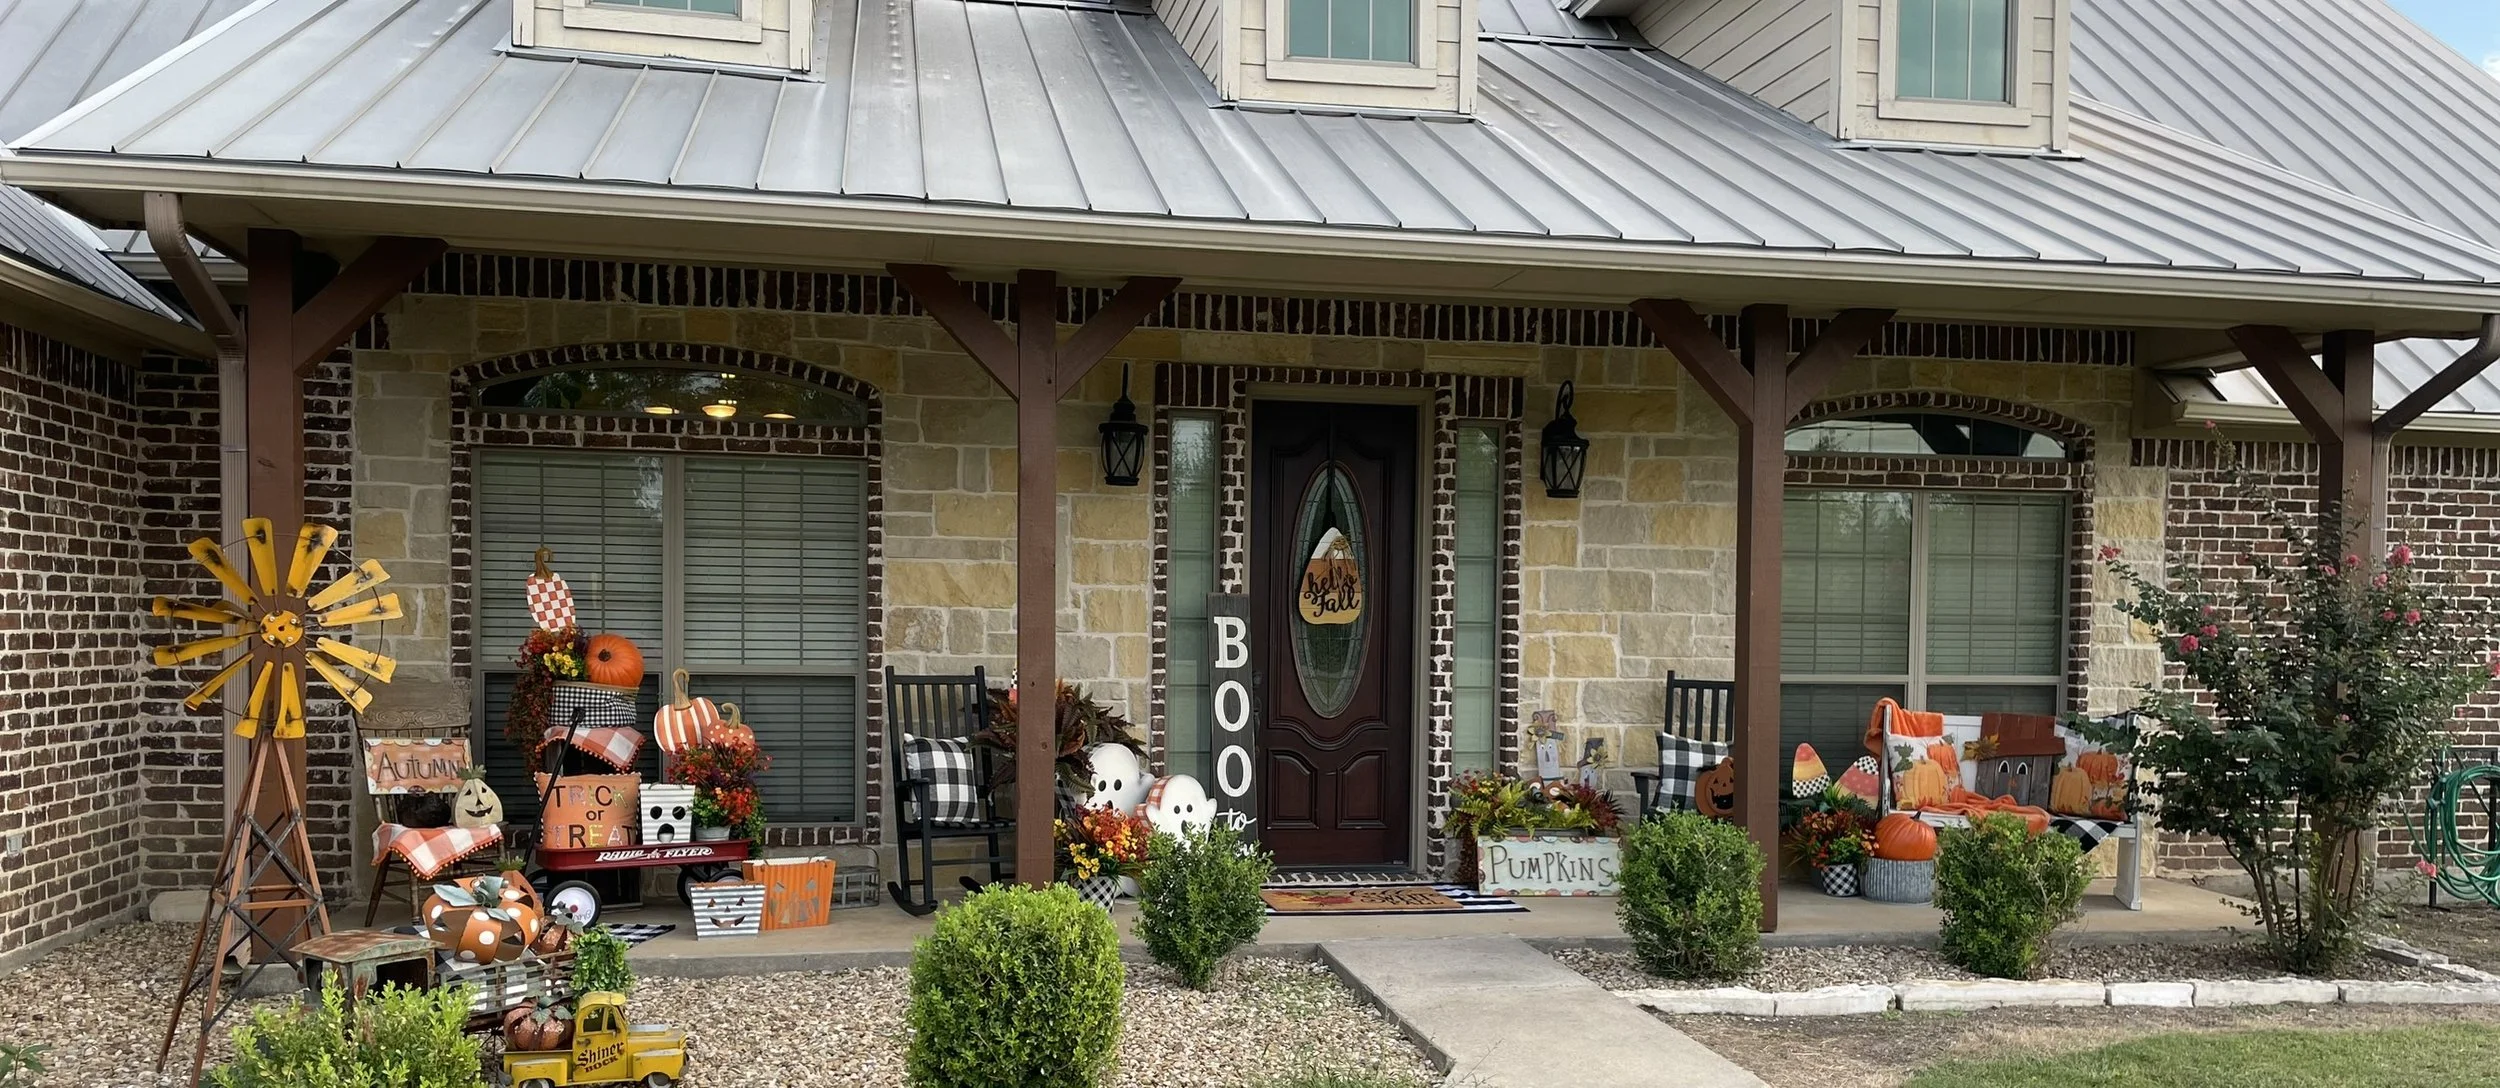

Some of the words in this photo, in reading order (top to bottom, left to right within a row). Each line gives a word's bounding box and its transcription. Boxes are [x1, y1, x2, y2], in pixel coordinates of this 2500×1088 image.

[1308, 566, 1358, 594] hello
[1304, 584, 1360, 617] Fall
[1213, 615, 1252, 797] BOO
[552, 785, 629, 809] TRICK
[586, 809, 604, 821] or
[1216, 807, 1257, 832] to
[553, 824, 634, 848] TREAT
[595, 849, 648, 862] RADIO
[663, 847, 713, 858] FLYER
[1487, 845, 1614, 888] PUMPKINS
[575, 1041, 624, 1067] Shiner
[584, 1056, 618, 1073] BOCK
